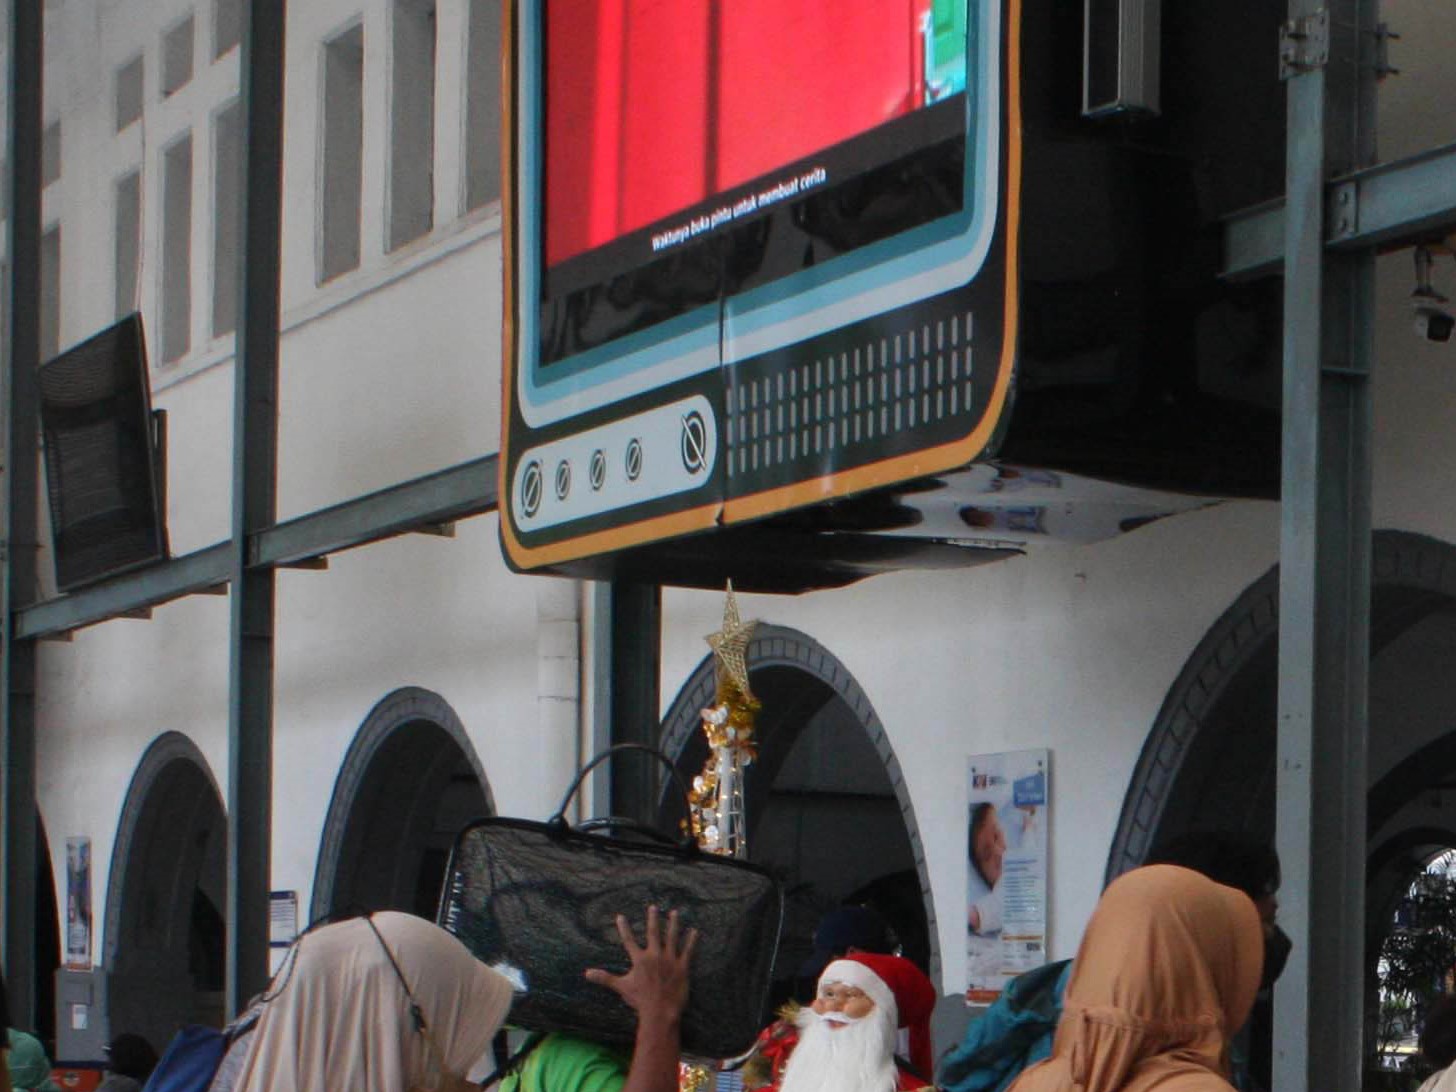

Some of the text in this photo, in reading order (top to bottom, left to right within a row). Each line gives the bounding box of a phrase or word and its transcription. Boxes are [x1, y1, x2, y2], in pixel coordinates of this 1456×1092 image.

[652, 167, 826, 251] Waktunya buka pintu untuk membuat cerita
